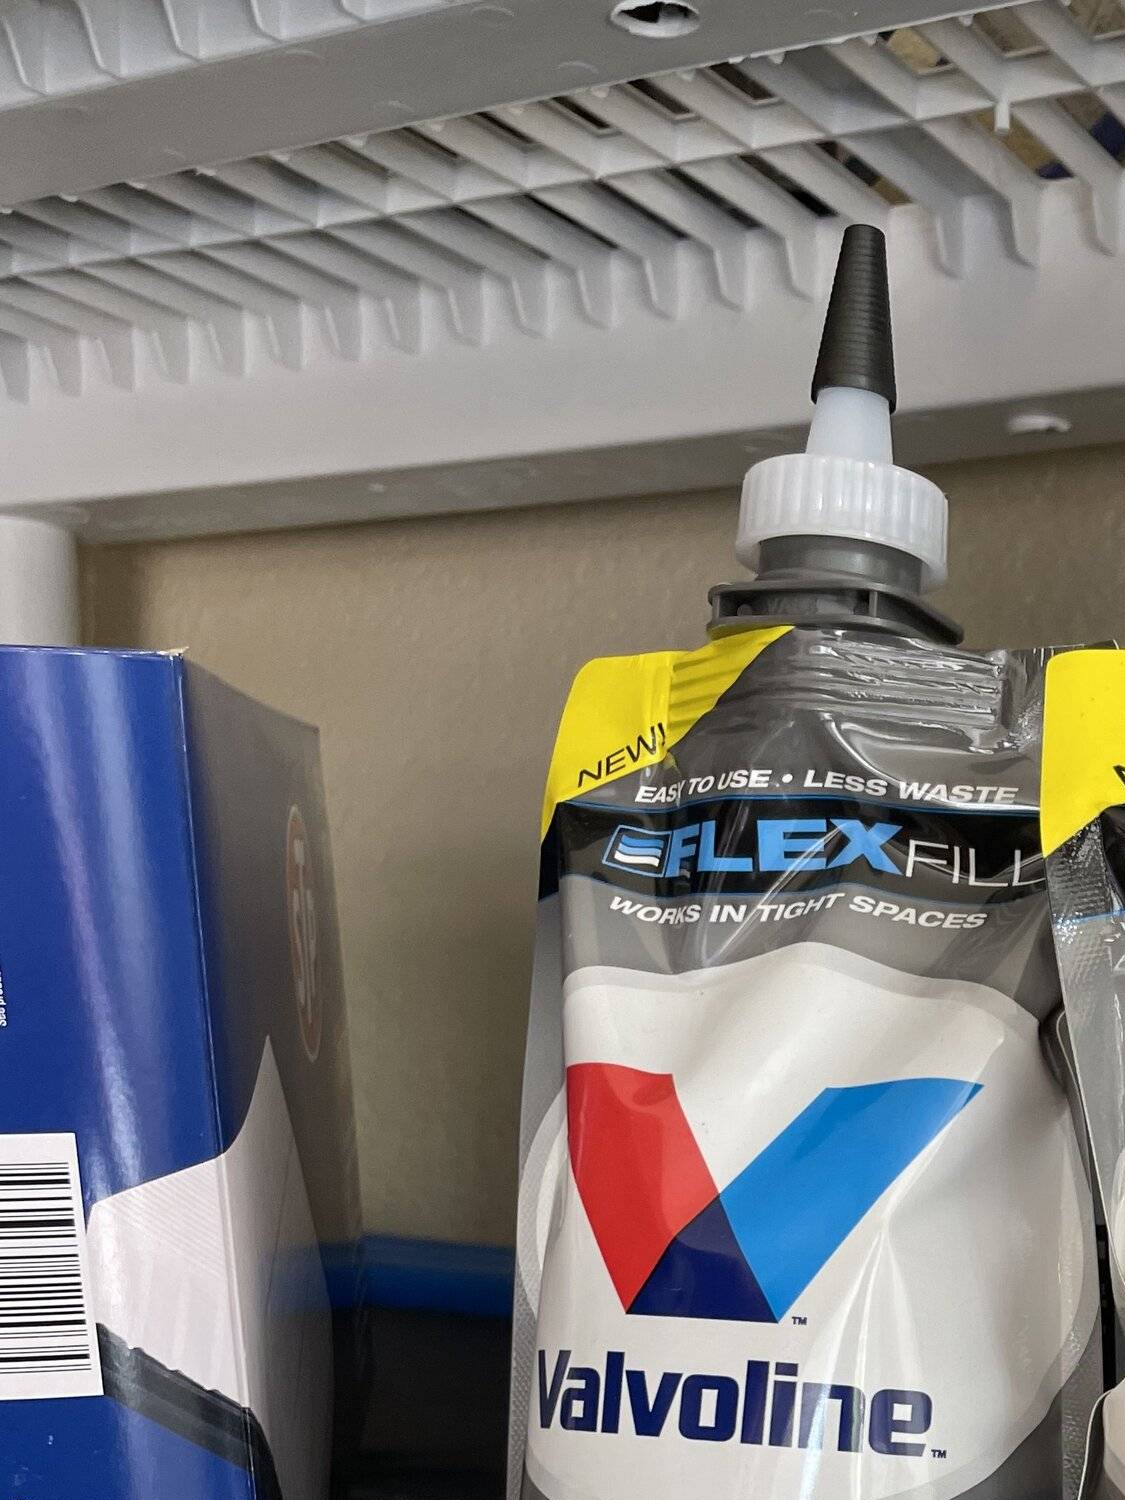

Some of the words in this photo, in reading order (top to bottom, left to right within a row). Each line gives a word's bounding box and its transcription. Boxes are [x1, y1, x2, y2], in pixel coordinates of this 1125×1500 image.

[577, 722, 666, 788] NEW!
[634, 779, 686, 804] EASY
[687, 776, 717, 795] TO
[718, 768, 774, 788] USE
[804, 769, 888, 796] LESS
[898, 781, 1019, 805] WASTE
[609, 895, 702, 925] WORKS
[708, 903, 747, 924] IN
[755, 892, 846, 923] TIGHT
[849, 895, 988, 930] SPACES
[537, 1349, 933, 1458] Valvoline
